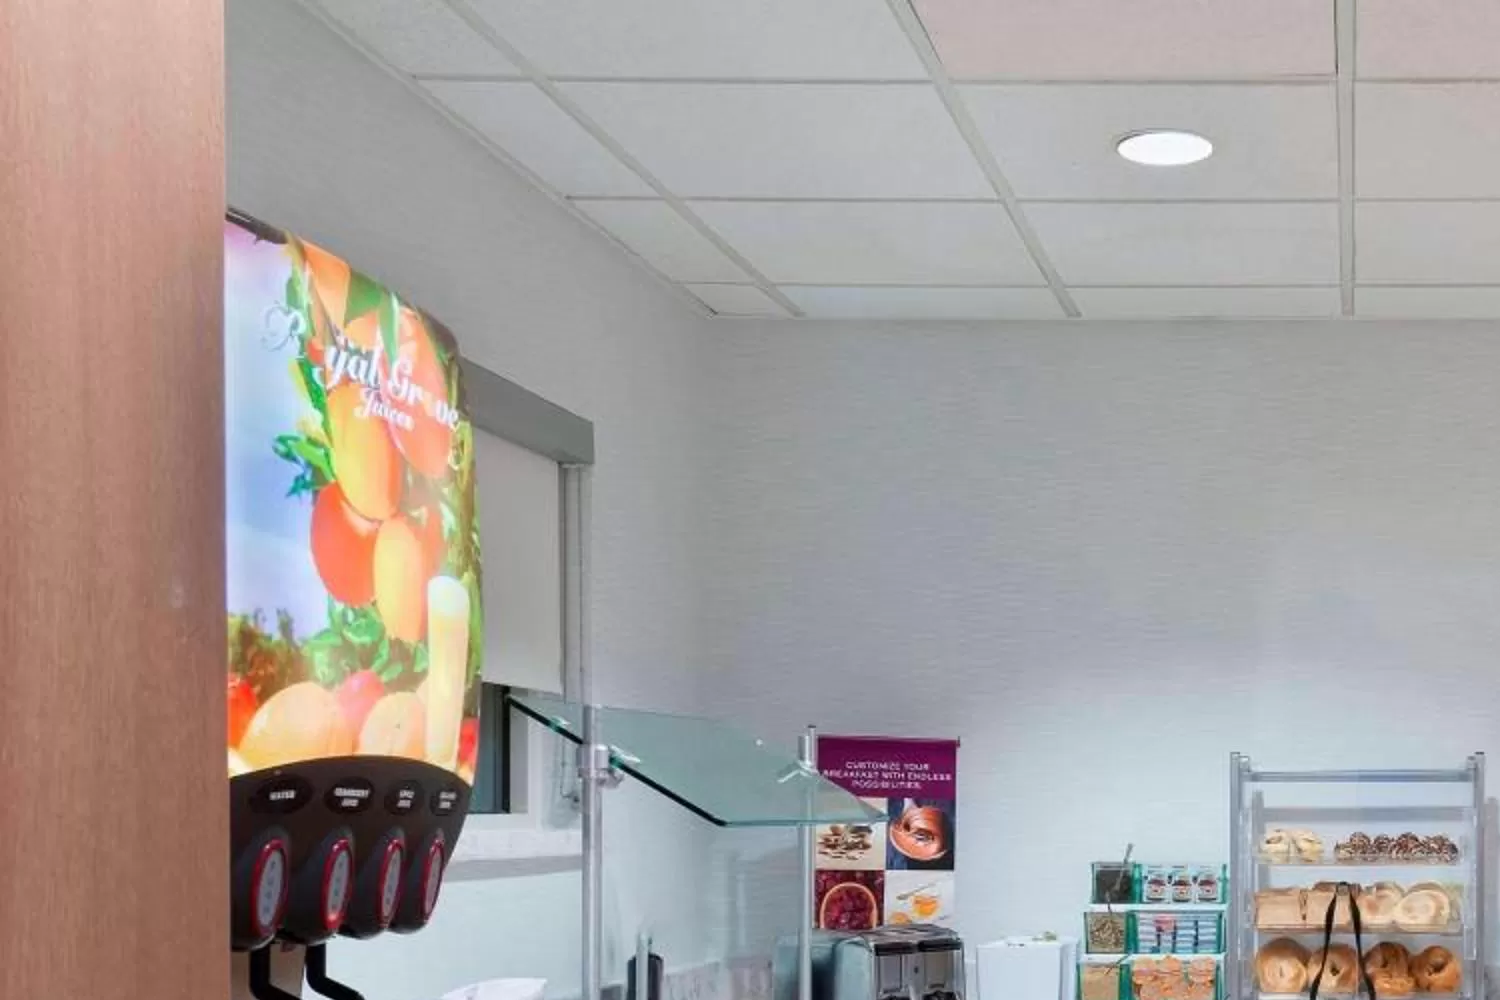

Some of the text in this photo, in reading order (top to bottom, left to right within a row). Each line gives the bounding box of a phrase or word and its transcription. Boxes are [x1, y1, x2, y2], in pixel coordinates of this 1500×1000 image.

[353, 387, 414, 431] Juices
[845, 761, 930, 771] CUSTOMIZE YOUR
[881, 771, 905, 780] WITH
[907, 772, 953, 781] ENDLESS
